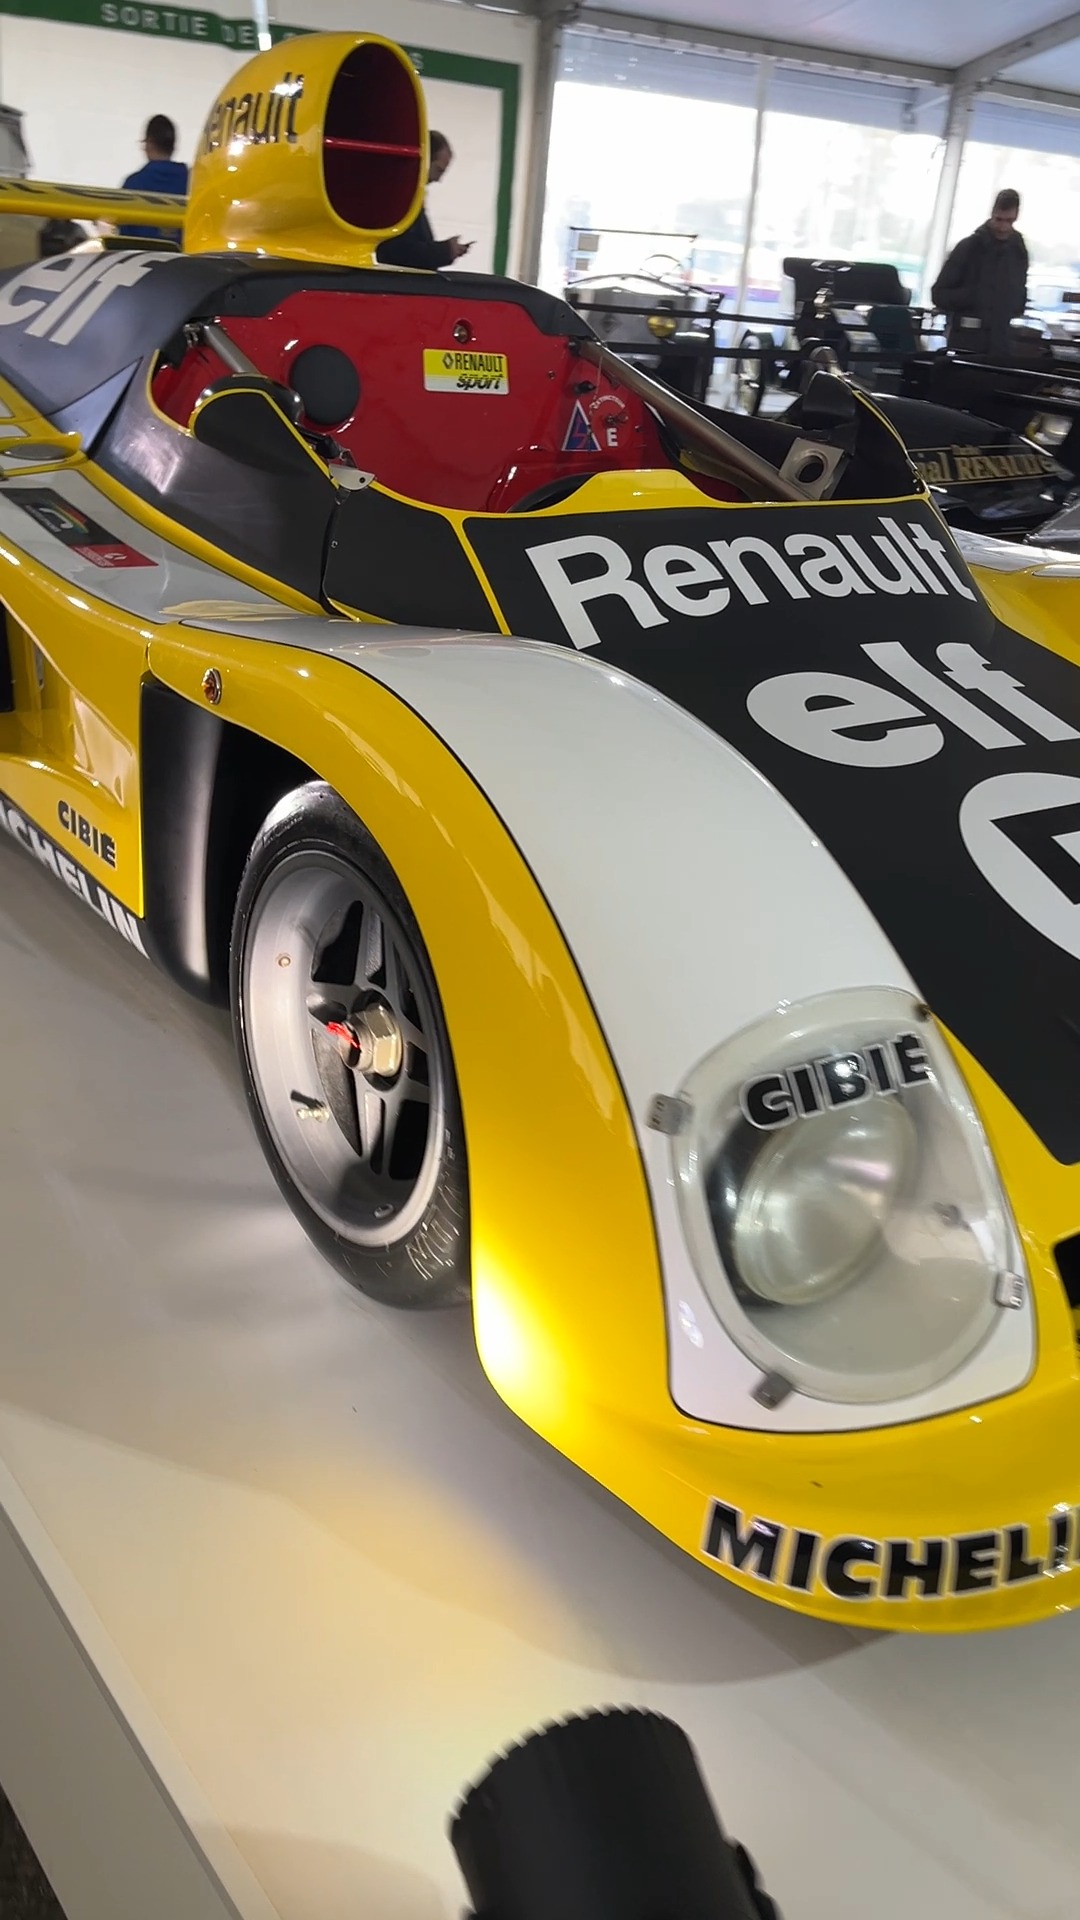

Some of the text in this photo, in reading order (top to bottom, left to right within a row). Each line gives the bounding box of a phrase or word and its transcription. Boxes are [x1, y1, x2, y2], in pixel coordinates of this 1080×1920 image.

[100, 2, 209, 37] SORTIE
[0, 250, 190, 346] elf
[454, 353, 504, 373] RENAULT
[606, 427, 619, 447] E
[525, 516, 978, 650] Renault
[746, 641, 1080, 768] elf
[701, 1498, 1080, 1600] MICHELI
